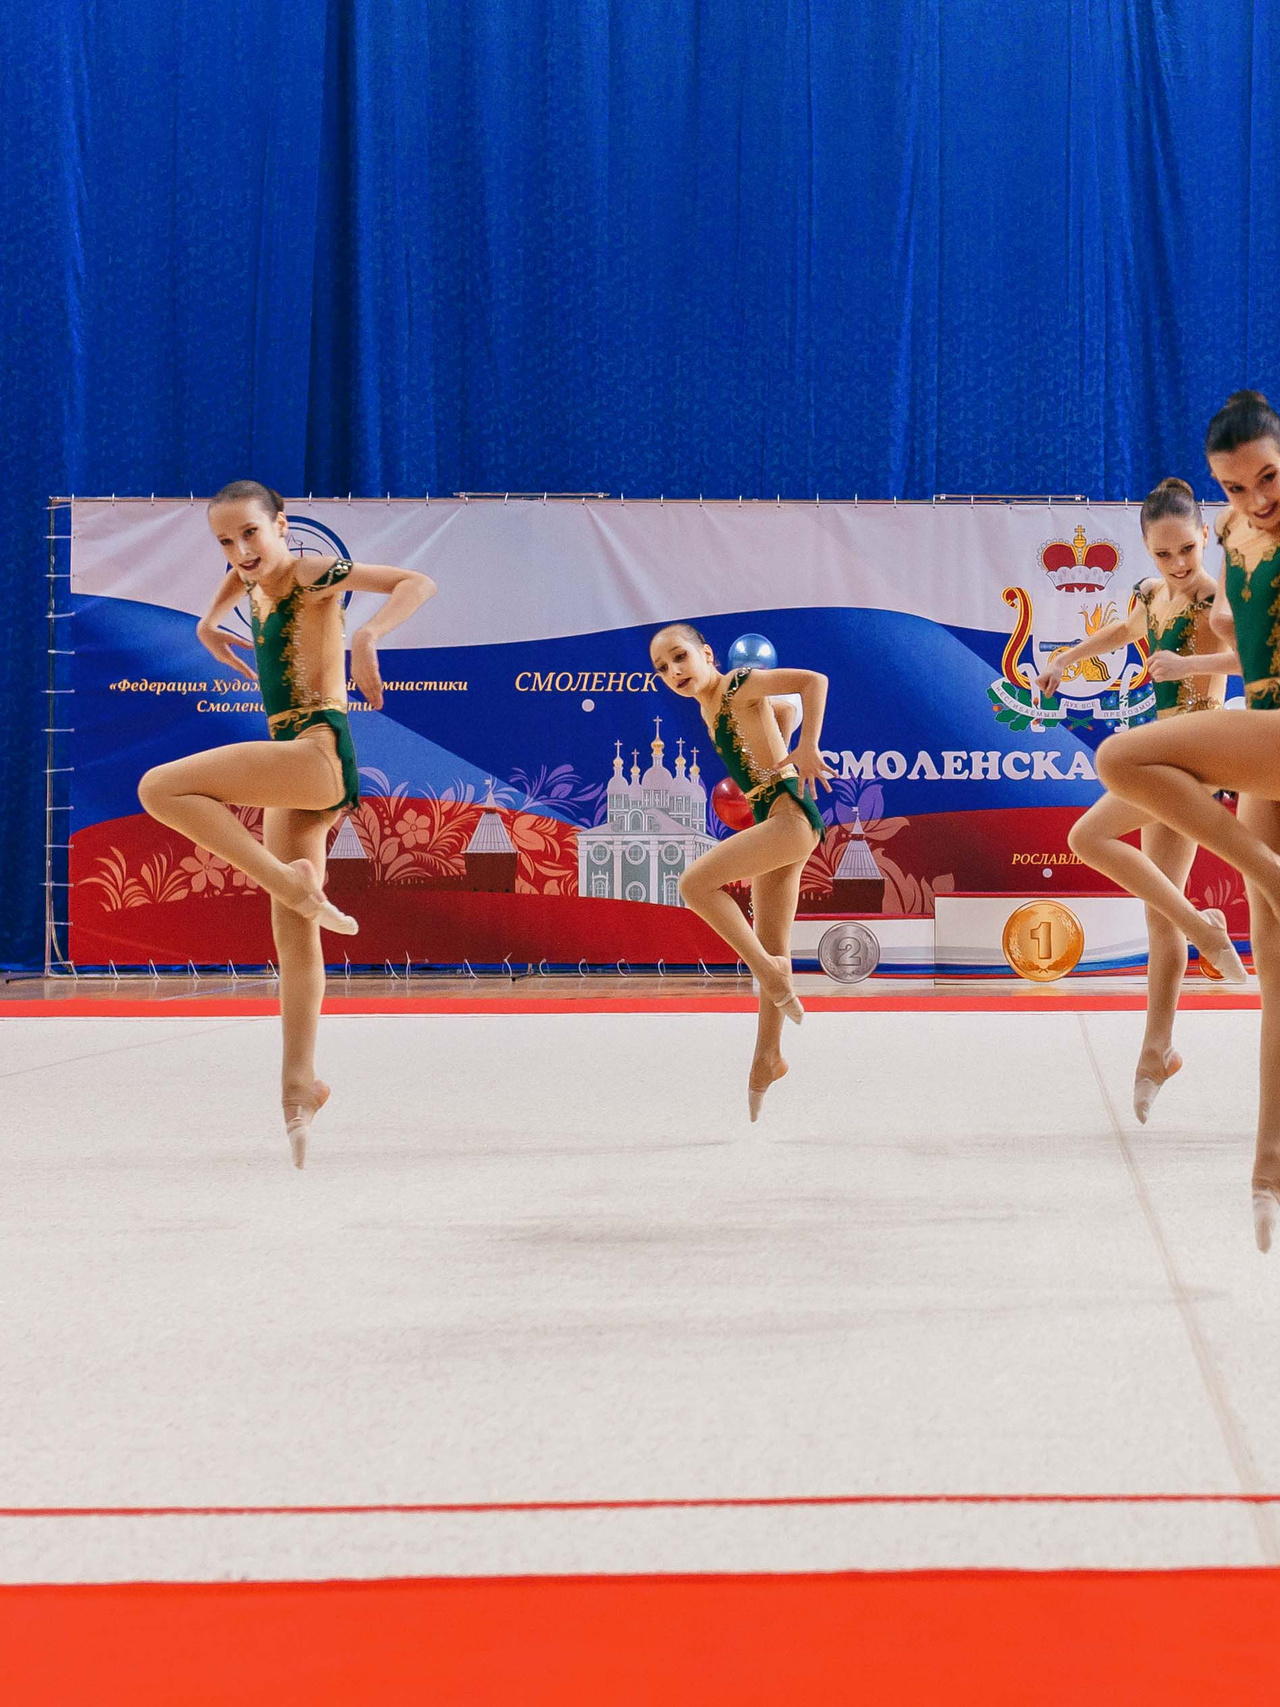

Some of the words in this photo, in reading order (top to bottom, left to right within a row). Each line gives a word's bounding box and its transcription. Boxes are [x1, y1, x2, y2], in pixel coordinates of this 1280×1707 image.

[109, 679, 208, 696] «Федерация
[381, 680, 468, 692] мнастики
[515, 671, 660, 692] СМОЛЕНСК
[1063, 700, 1079, 709] ДУХ
[1081, 700, 1097, 709] ВСЕ
[819, 750, 1099, 781] СМОЛЕНСКА
[1030, 921, 1053, 960] 1
[837, 941, 862, 966] 2
